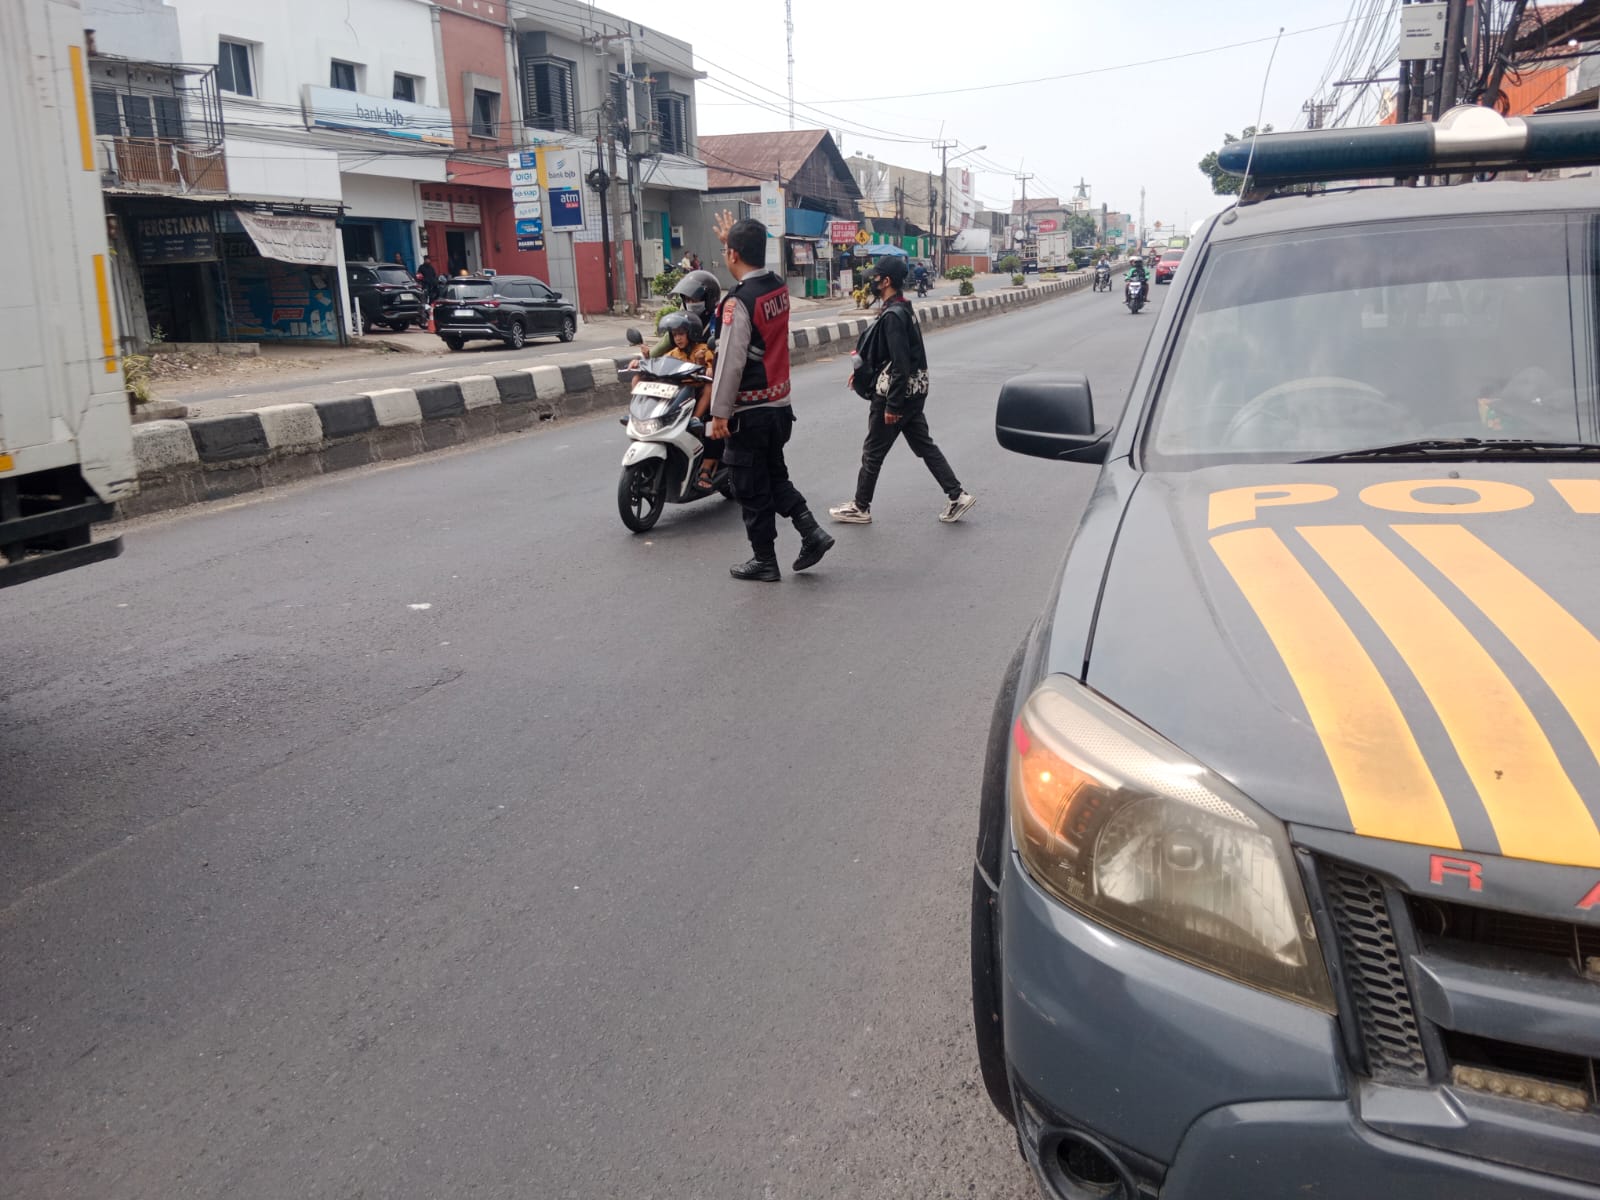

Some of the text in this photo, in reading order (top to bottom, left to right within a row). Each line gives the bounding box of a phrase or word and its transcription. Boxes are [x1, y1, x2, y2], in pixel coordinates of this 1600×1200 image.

[356, 103, 404, 127] bank bjb
[565, 170, 576, 180] bjb
[560, 194, 579, 203] atm
[138, 216, 210, 235] PERCETAKAN
